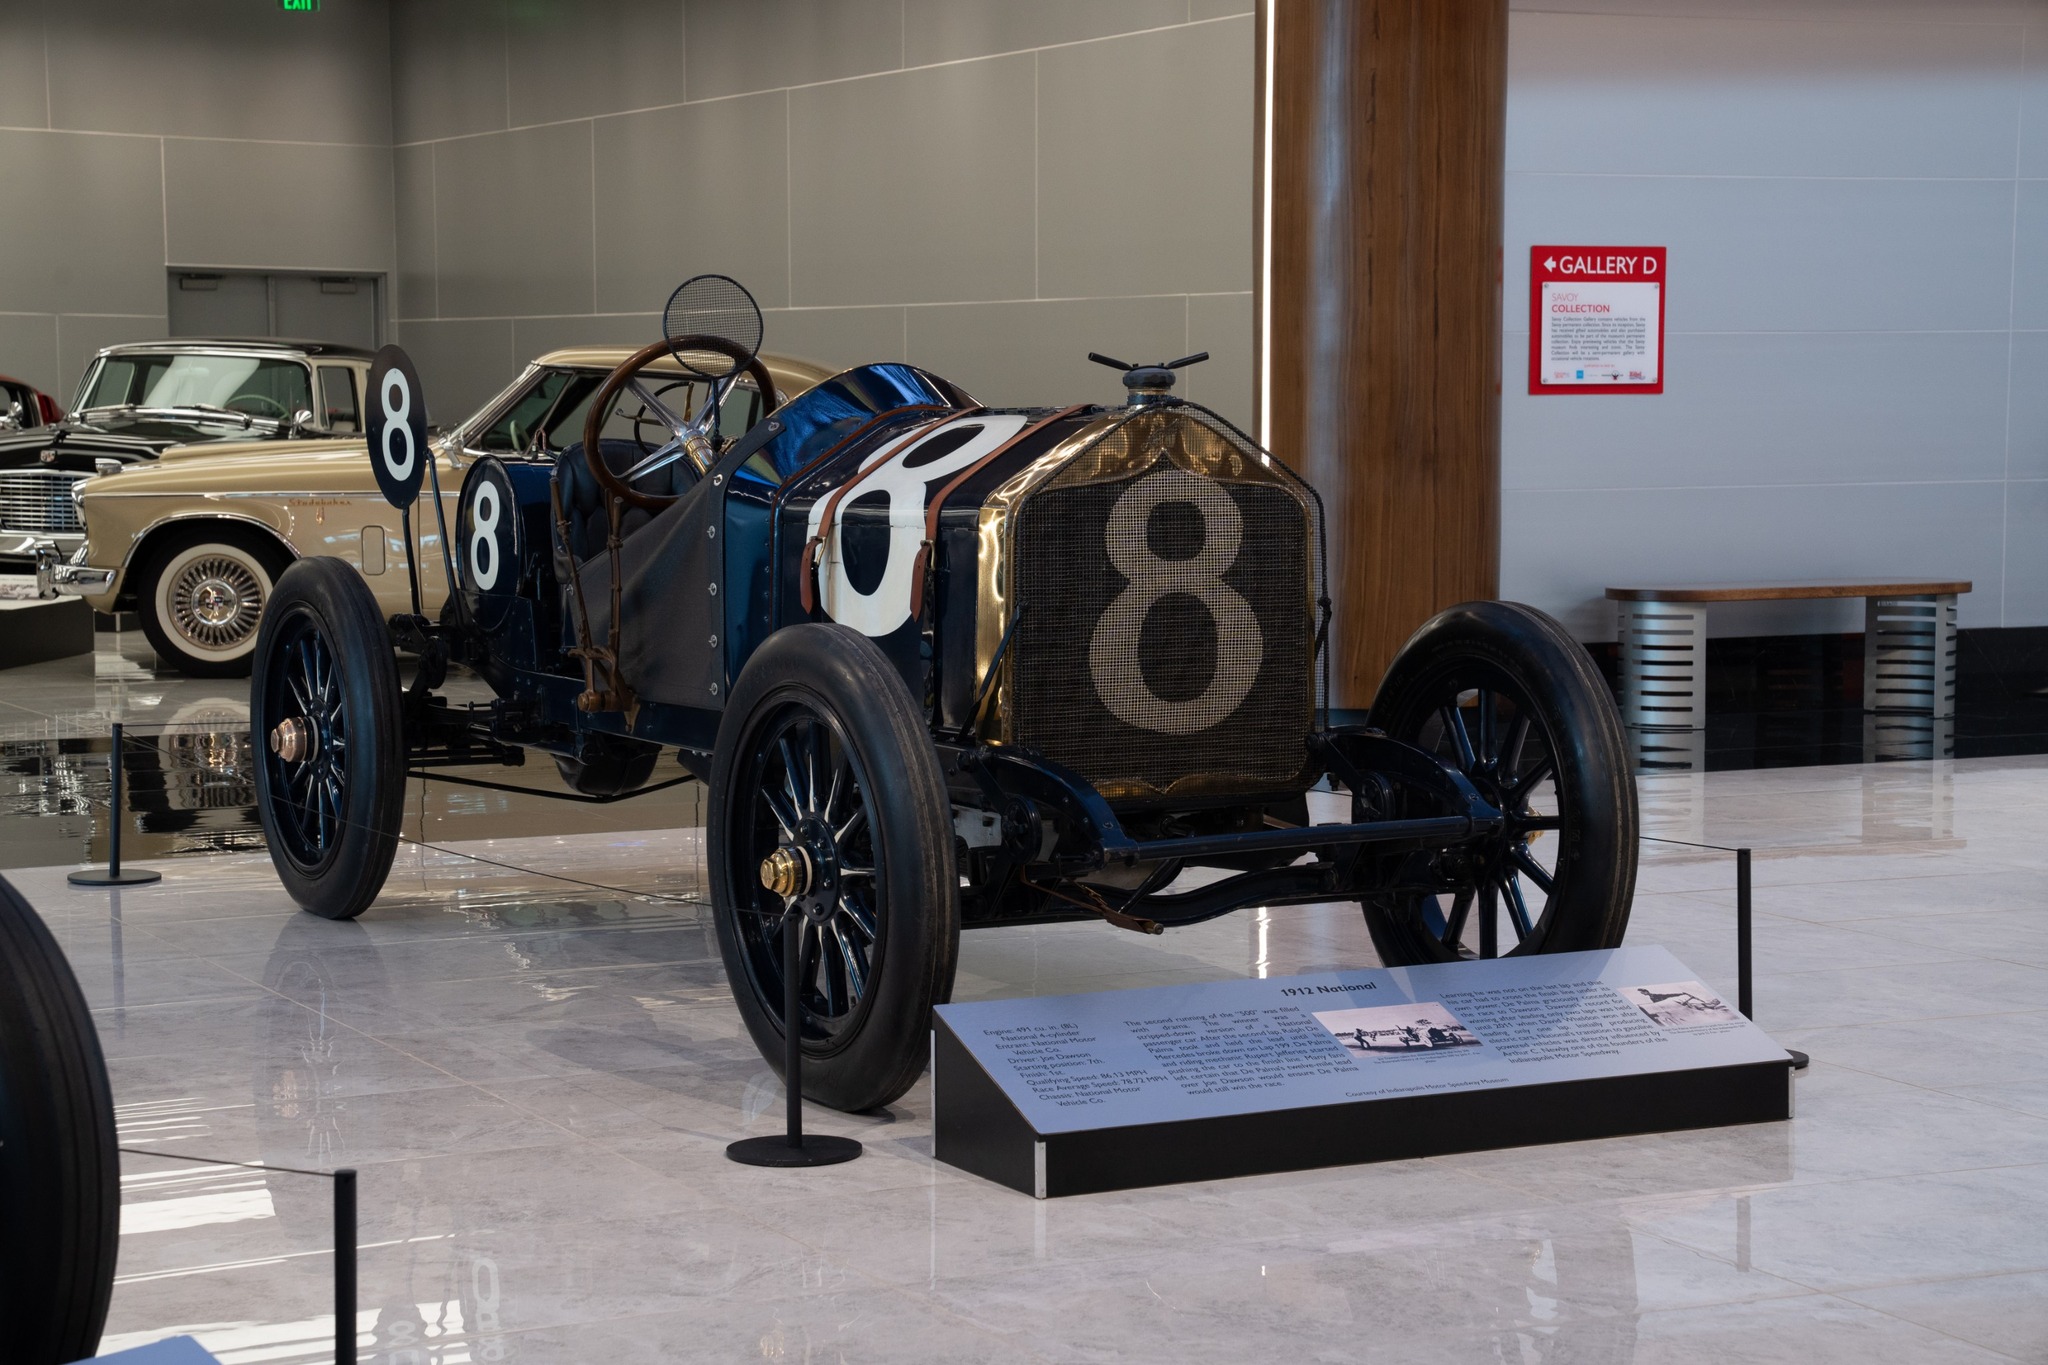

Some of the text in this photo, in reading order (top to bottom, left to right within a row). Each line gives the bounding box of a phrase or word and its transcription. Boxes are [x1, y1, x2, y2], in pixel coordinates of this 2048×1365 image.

[1559, 255, 1657, 275] GALLERY D
[1551, 292, 1579, 302] SAVOY
[1551, 304, 1610, 313] COLLECTION
[381, 367, 415, 481] 8
[806, 414, 1027, 637] 8
[470, 480, 500, 591] 8
[1089, 469, 1263, 734] 8
[1281, 982, 1376, 996] 1912 National
[1144, 1017, 1173, 1025] second
[1137, 1031, 1196, 1040] stripped-down
[1143, 1039, 1181, 1047] passenger
[1238, 1030, 1267, 1038] second
[1168, 1067, 1201, 1075] pushing
[1287, 1061, 1333, 1070] twelve-mile
[1026, 1078, 1071, 1086] Qualifying
